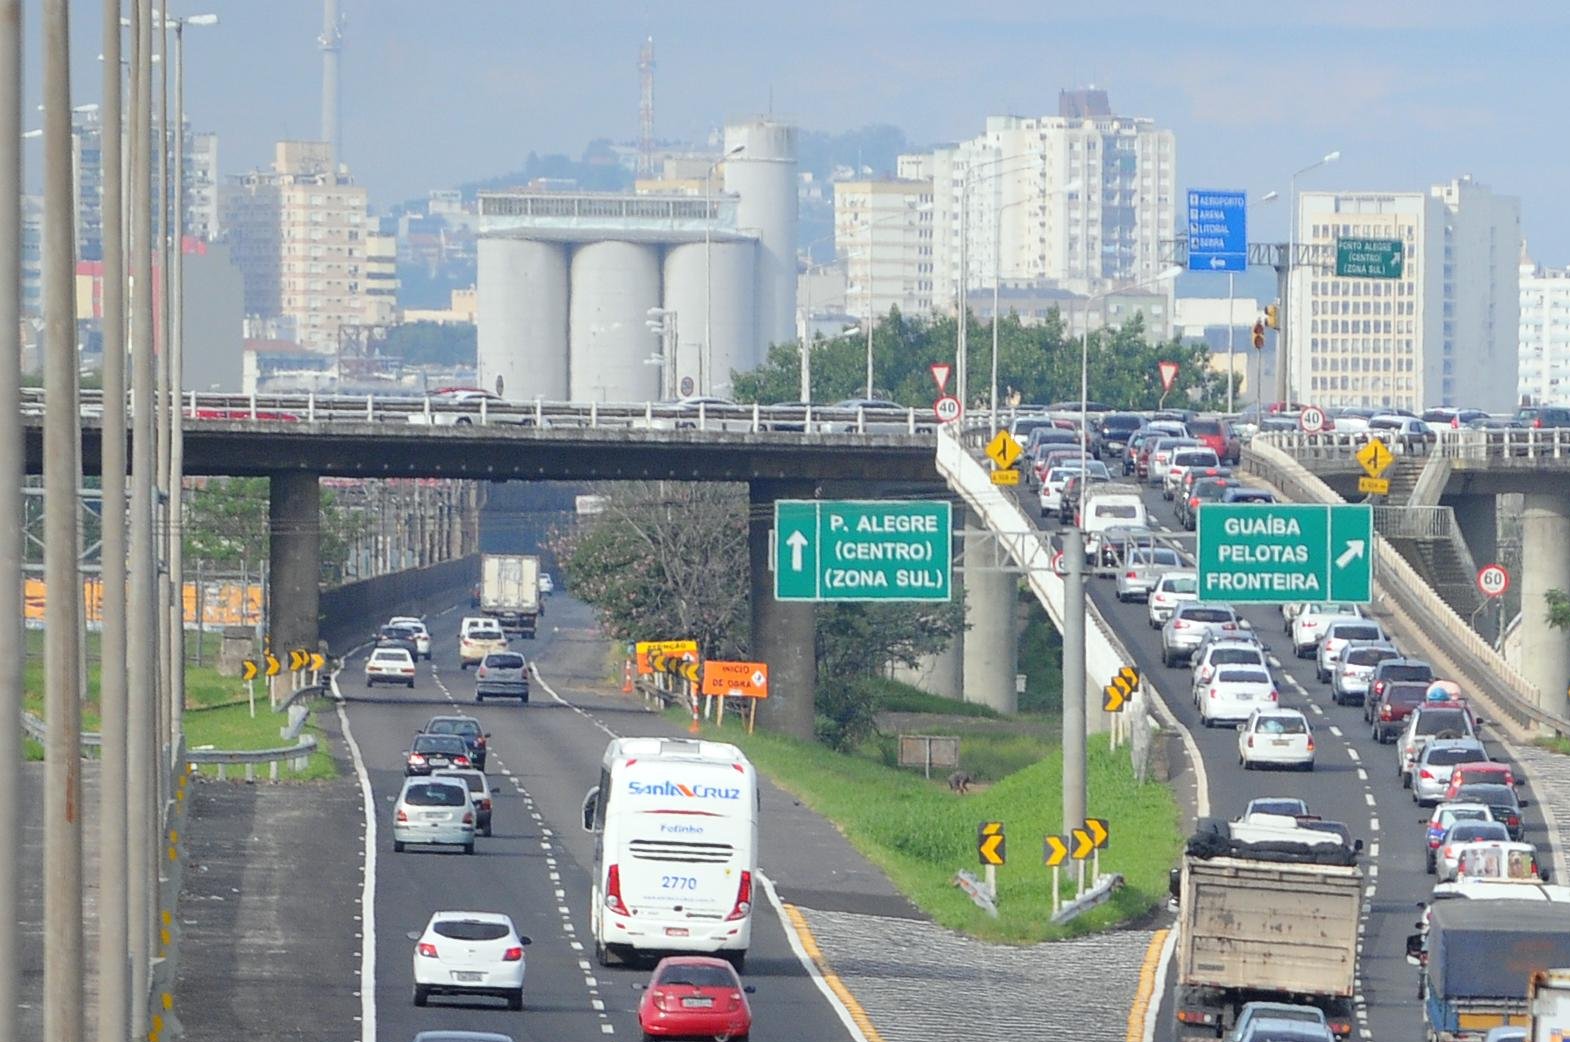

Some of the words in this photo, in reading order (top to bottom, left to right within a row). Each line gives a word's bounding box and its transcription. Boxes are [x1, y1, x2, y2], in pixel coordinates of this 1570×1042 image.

[1338, 240, 1362, 250] PORTO
[1365, 242, 1392, 251] ALEGRE
[1343, 263, 1367, 273] (ZONA
[1368, 264, 1385, 274] SUL)
[940, 402, 956, 413] 40
[1304, 412, 1320, 424] 40
[830, 514, 849, 532] P.
[857, 515, 938, 532] ALEGRE
[1224, 513, 1301, 536] GUAÍBA
[835, 541, 932, 560] (CENTRO)
[1218, 545, 1309, 562] PELOTAS
[825, 568, 888, 588] (ZONA
[896, 568, 943, 588] SUL)
[1206, 572, 1320, 590] FRONTEIRA
[1484, 571, 1502, 585] 60
[662, 876, 697, 889] 2770
